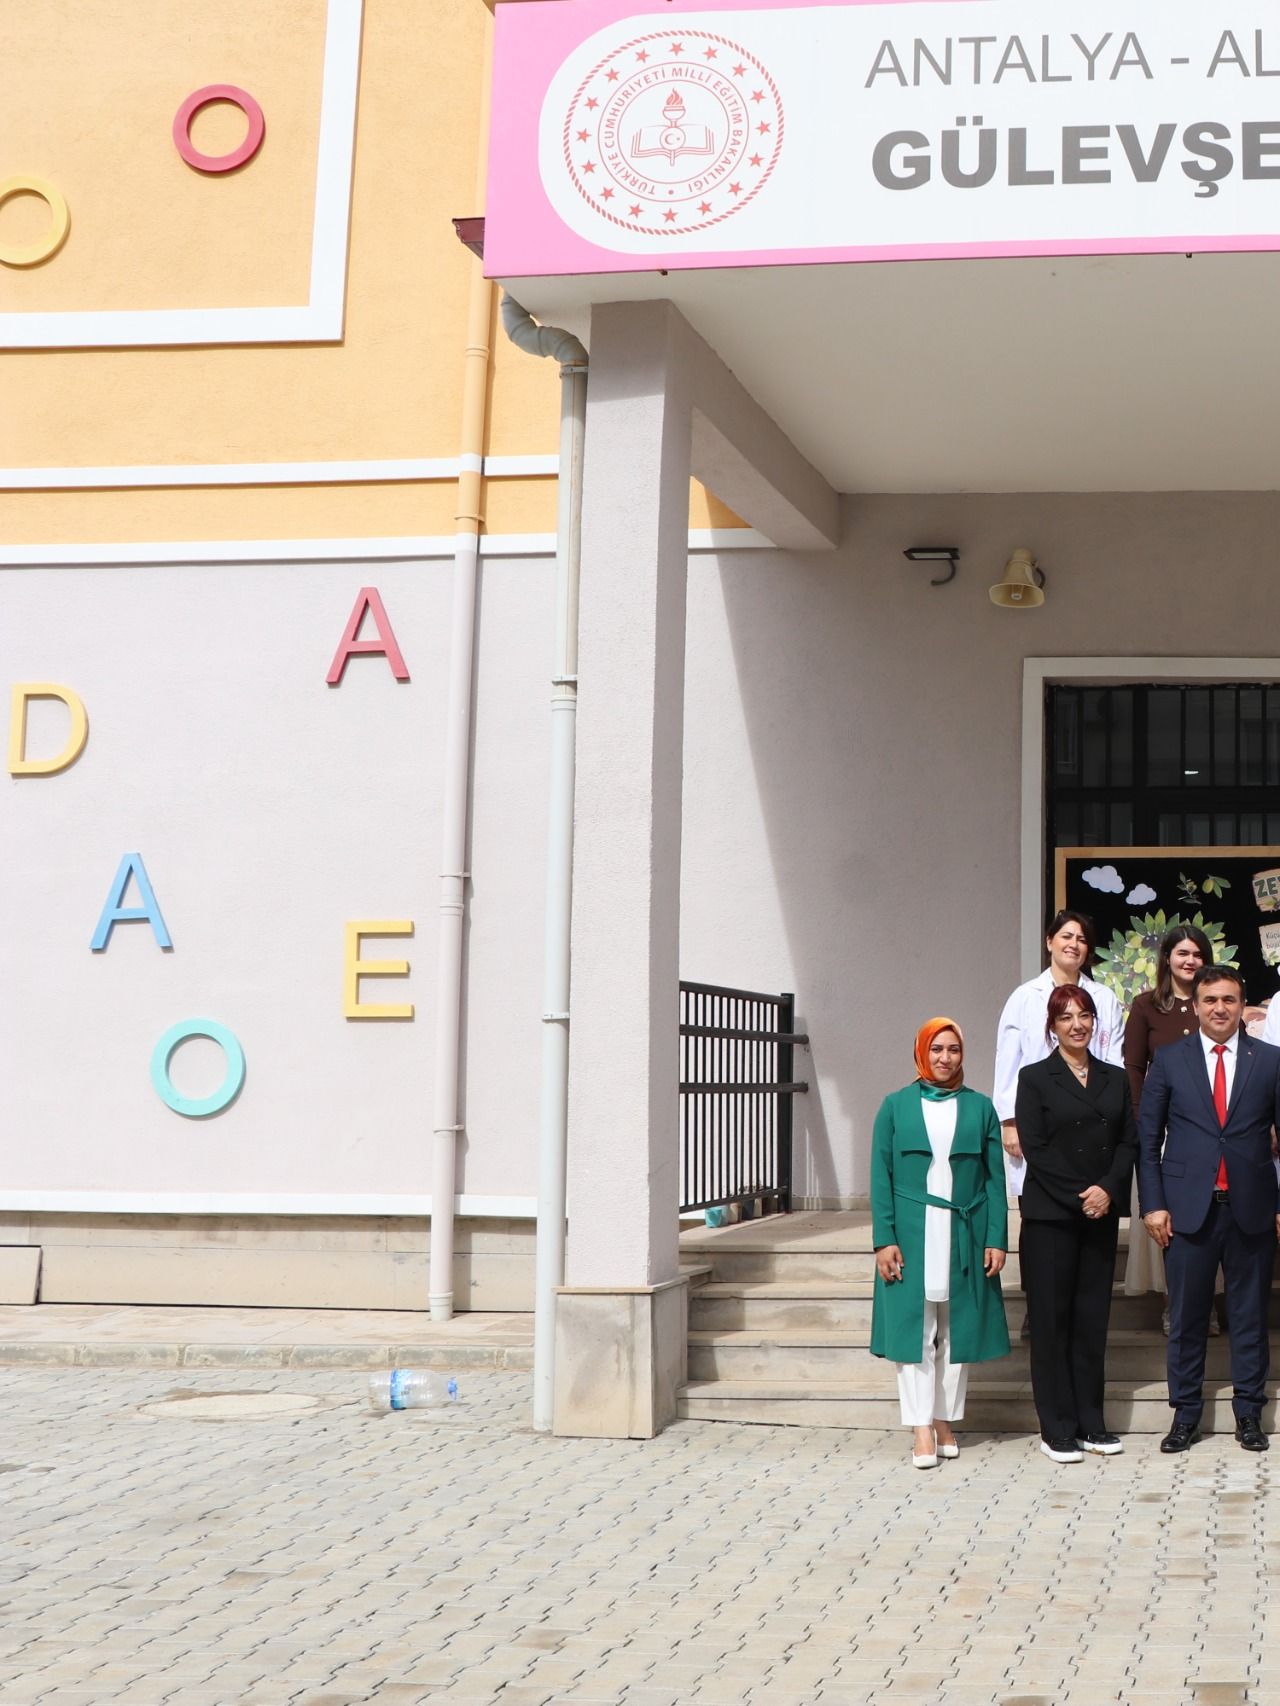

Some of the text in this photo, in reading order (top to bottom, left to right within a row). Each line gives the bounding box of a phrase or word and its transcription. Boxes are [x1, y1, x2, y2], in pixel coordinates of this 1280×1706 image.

[864, 31, 1154, 89] ANTALYA
[603, 65, 743, 196] TÜRKİYE CUMHURİYETİ MİLLİ EĞİTİM BAKANLIĞI
[326, 586, 410, 687] A
[8, 682, 89, 776] D
[89, 852, 172, 952] A
[344, 920, 415, 1019] E
